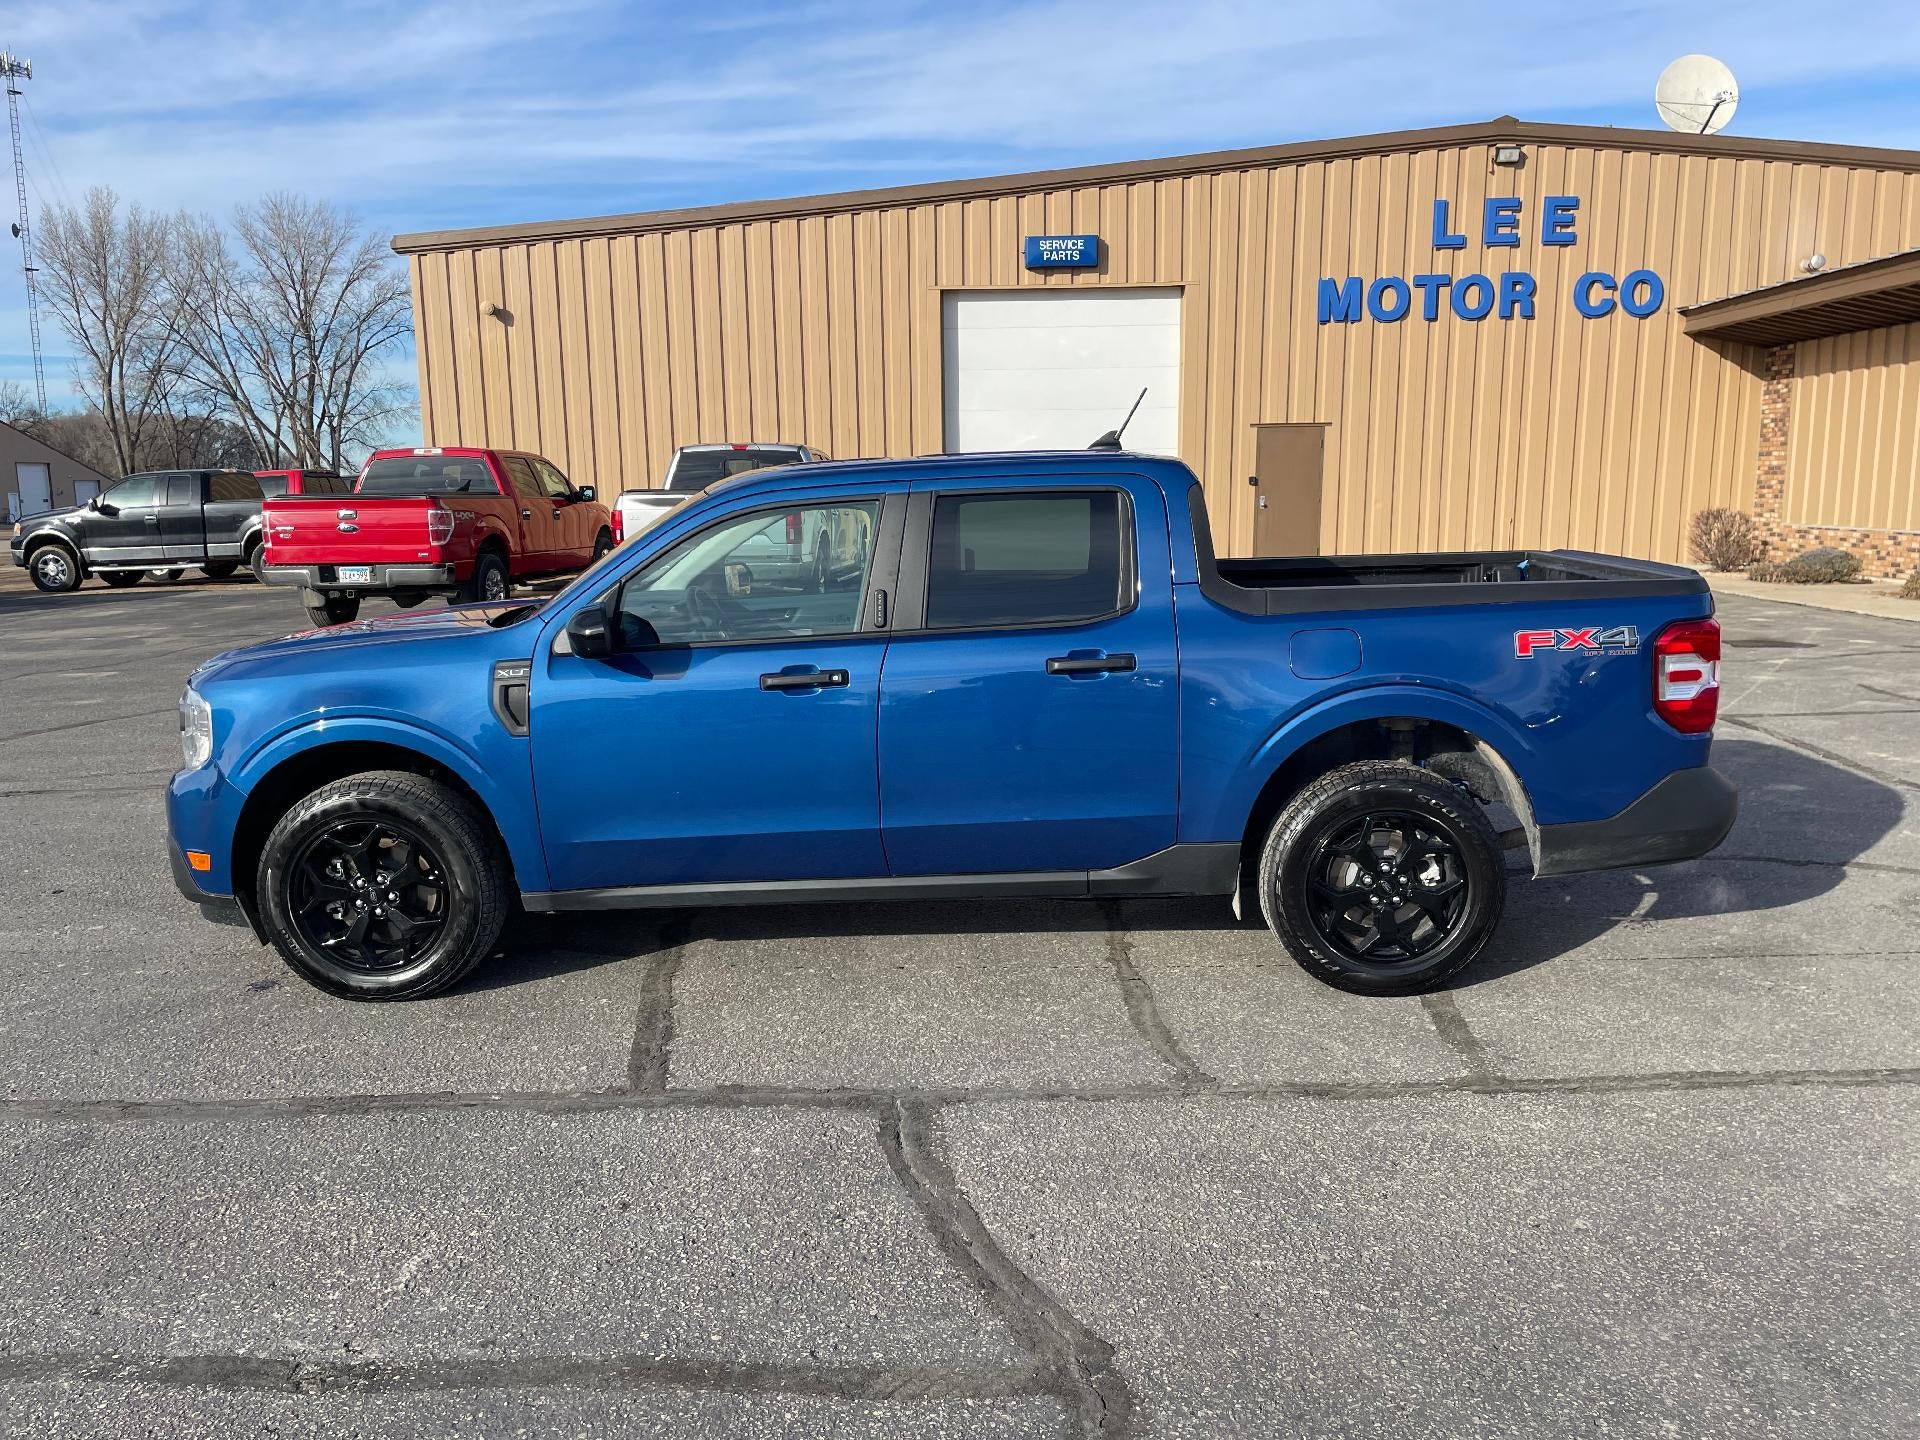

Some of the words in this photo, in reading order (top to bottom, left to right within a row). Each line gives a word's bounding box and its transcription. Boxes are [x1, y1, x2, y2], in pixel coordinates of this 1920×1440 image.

[1433, 196, 1581, 248] LEE
[1039, 240, 1084, 250] SERVICE
[1043, 250, 1080, 261] PARTS
[1318, 272, 1536, 324] MOTOR
[1574, 269, 1665, 320] CO
[1514, 626, 1640, 659] FX4
[498, 668, 530, 676] XLT
